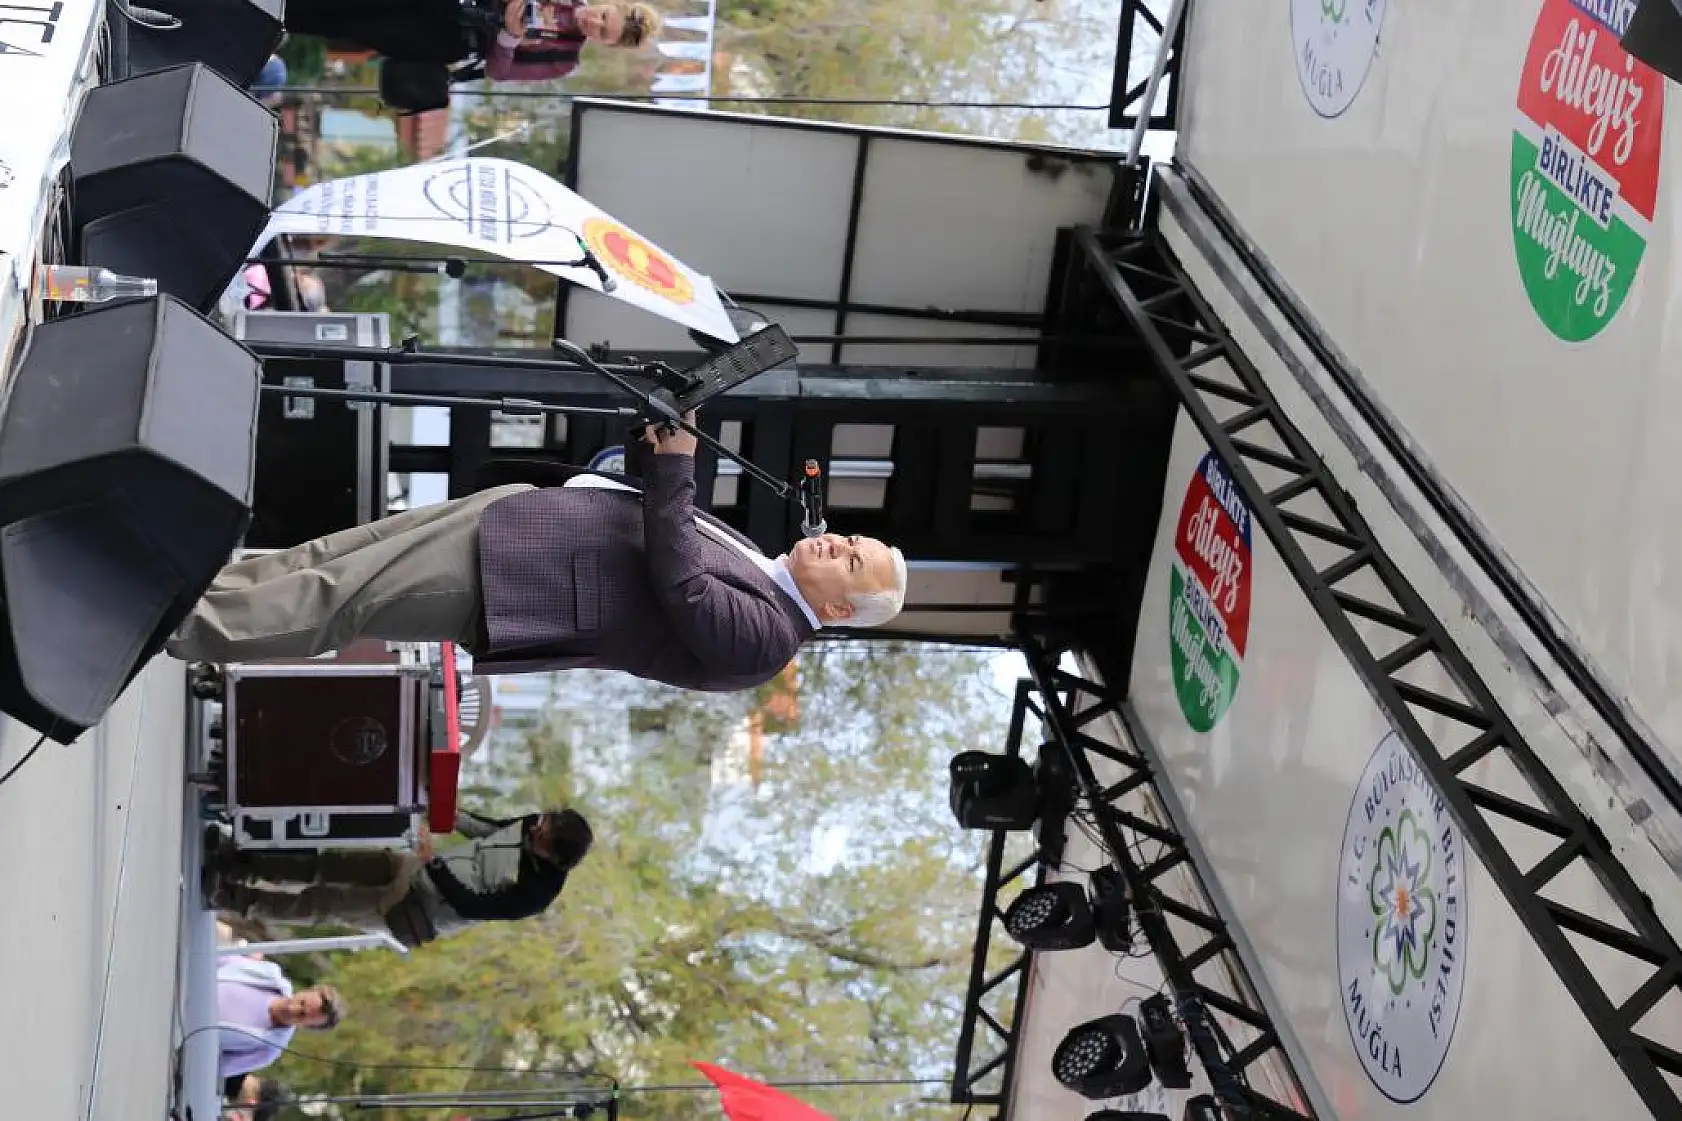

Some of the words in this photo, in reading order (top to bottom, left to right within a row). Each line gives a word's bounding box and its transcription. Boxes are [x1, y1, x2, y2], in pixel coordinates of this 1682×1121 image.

[1540, 18, 1644, 165] Aileyiz
[1540, 134, 1614, 224] BİRLİKTE
[1516, 170, 1616, 318] Muğlayız
[1206, 458, 1248, 534] BİRLİKTE
[1186, 496, 1244, 614] Aileyiz
[1185, 574, 1223, 652] BİRLİKTE
[1348, 976, 1402, 1080] MUĞLA
